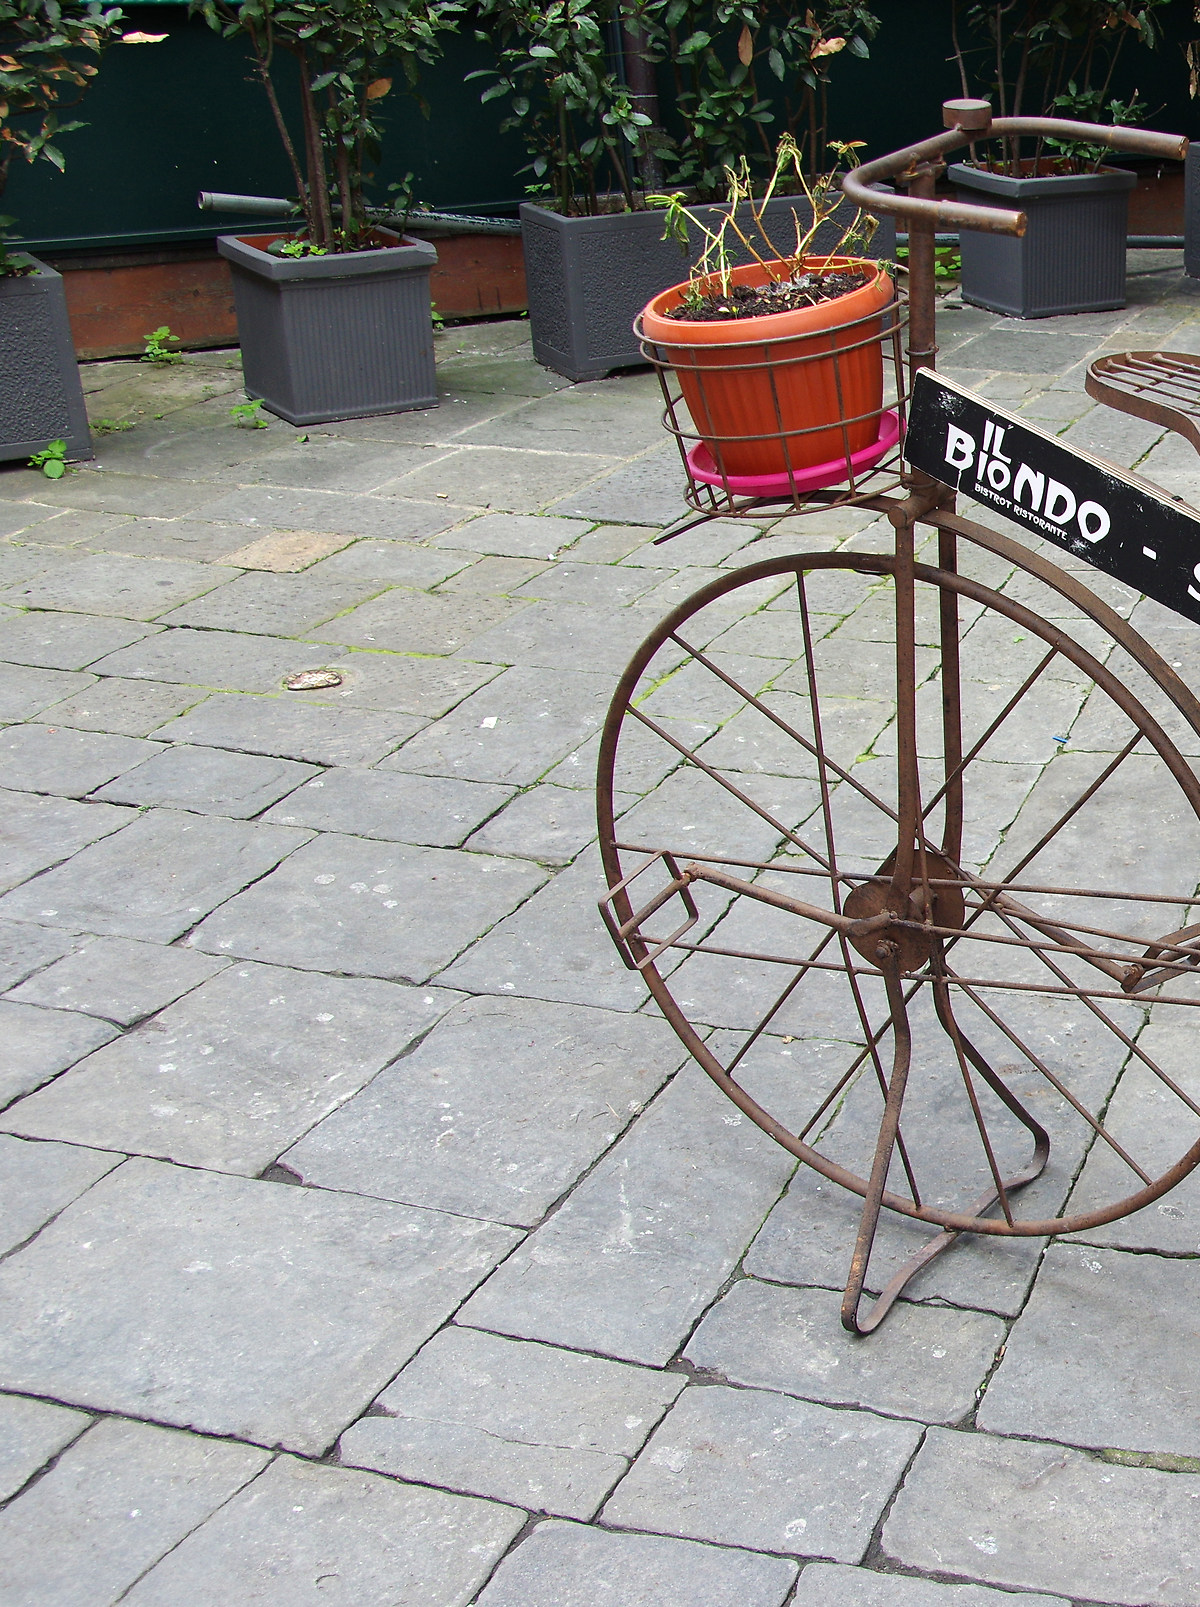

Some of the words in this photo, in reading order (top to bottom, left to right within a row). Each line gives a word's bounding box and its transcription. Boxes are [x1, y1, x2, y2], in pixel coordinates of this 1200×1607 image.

[982, 419, 1012, 464] IL
[944, 422, 1111, 544] BIONDO
[974, 482, 1013, 509] BISTROT
[1013, 504, 1068, 541] RISTORANTE
